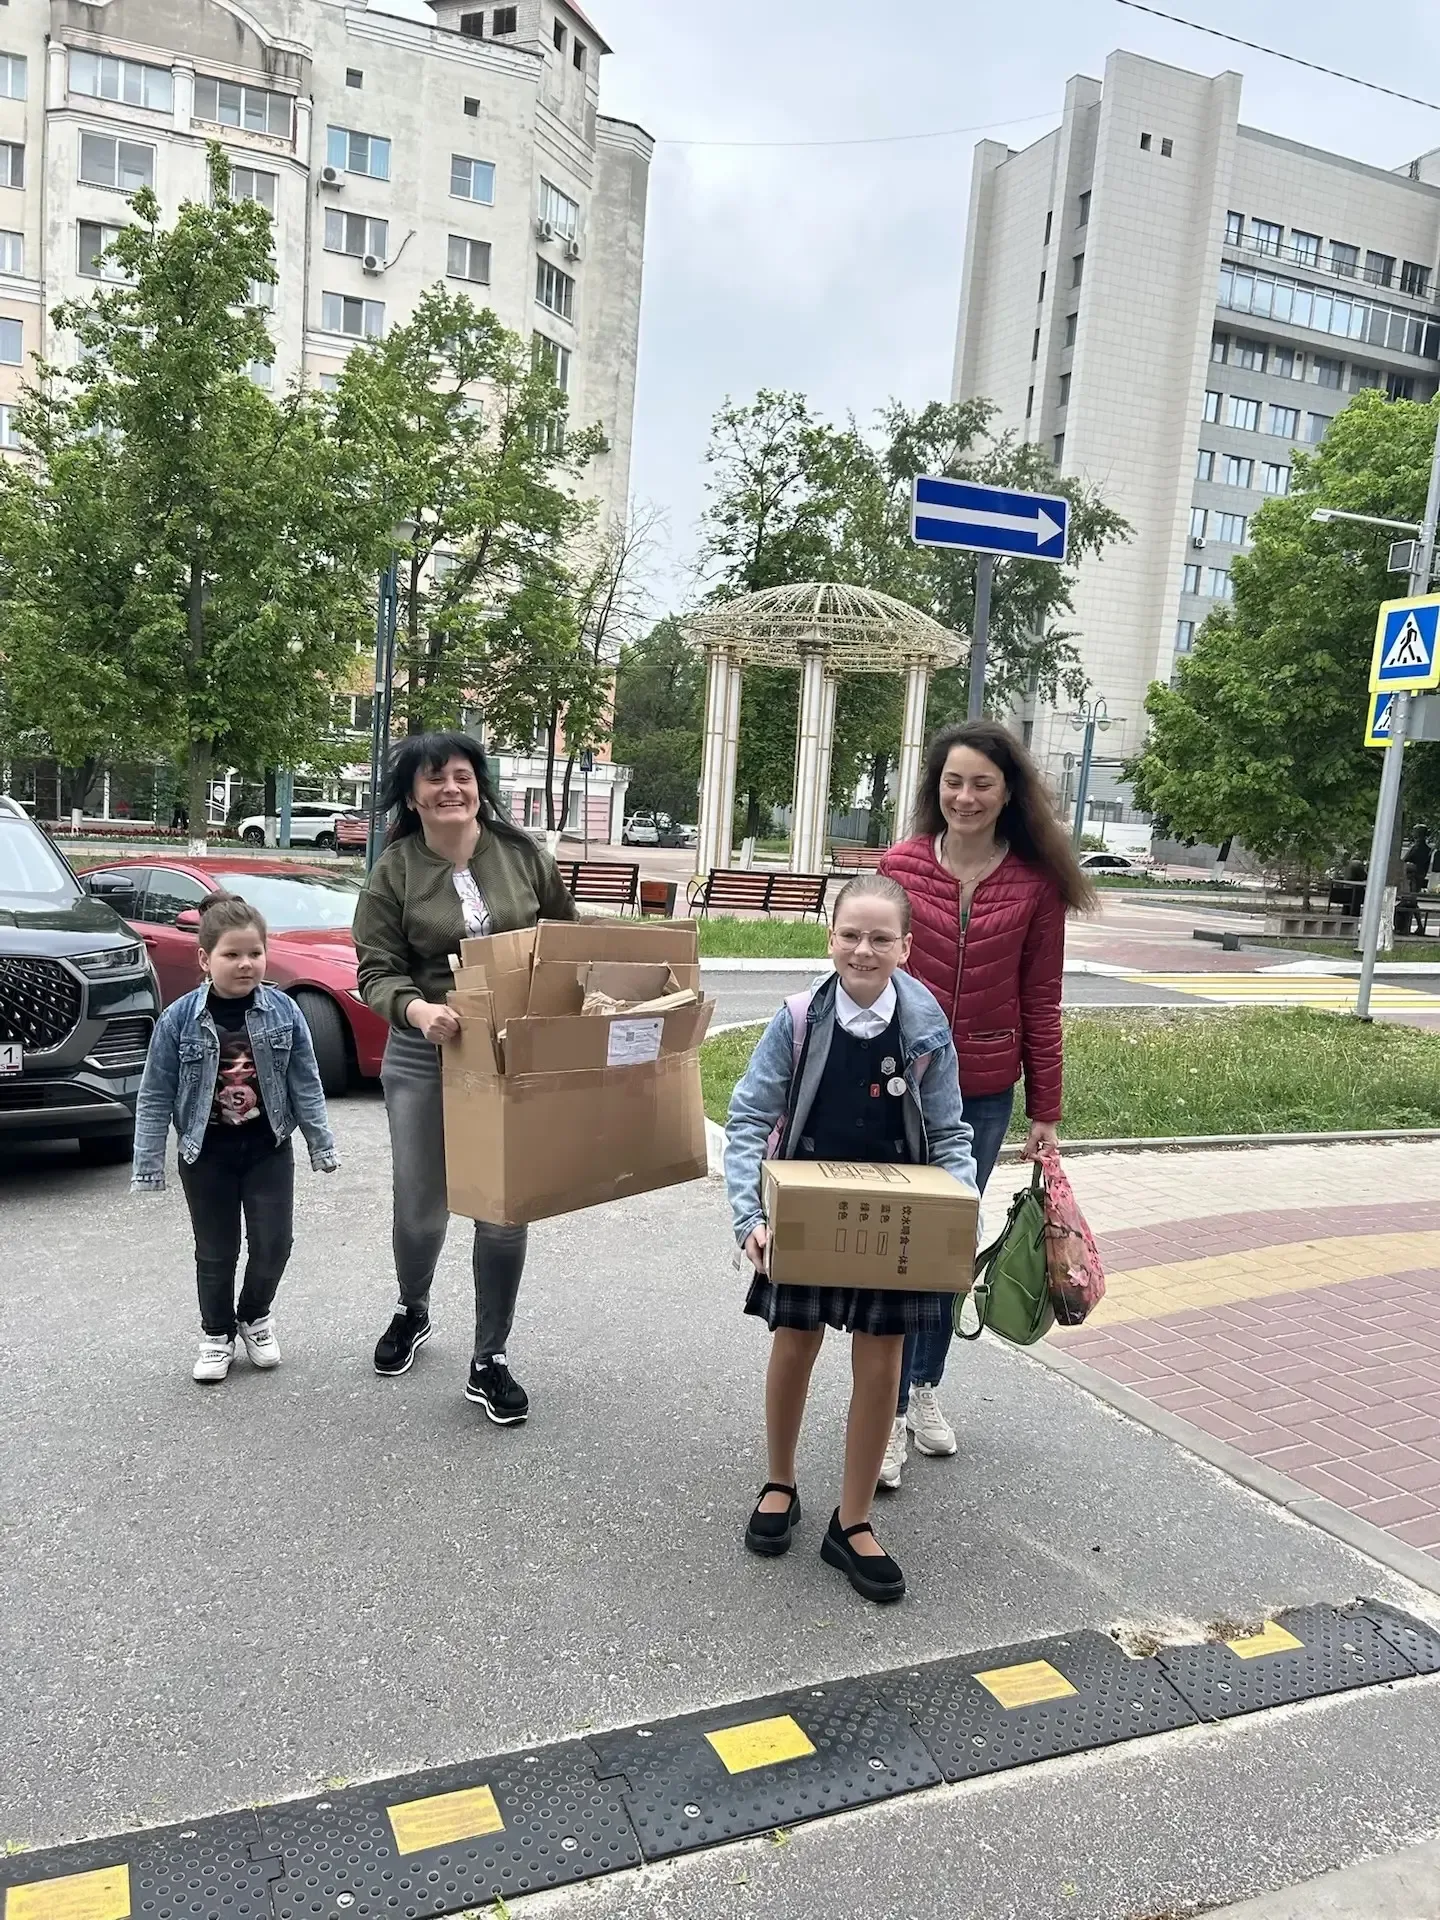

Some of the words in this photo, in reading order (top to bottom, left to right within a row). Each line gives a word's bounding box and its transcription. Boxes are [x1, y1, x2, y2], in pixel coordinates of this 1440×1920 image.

[233, 1091, 245, 1106] S
[837, 1201, 848, 1221] 粉色
[859, 1202, 870, 1222] 绿色
[880, 1203, 891, 1224] 蓝色
